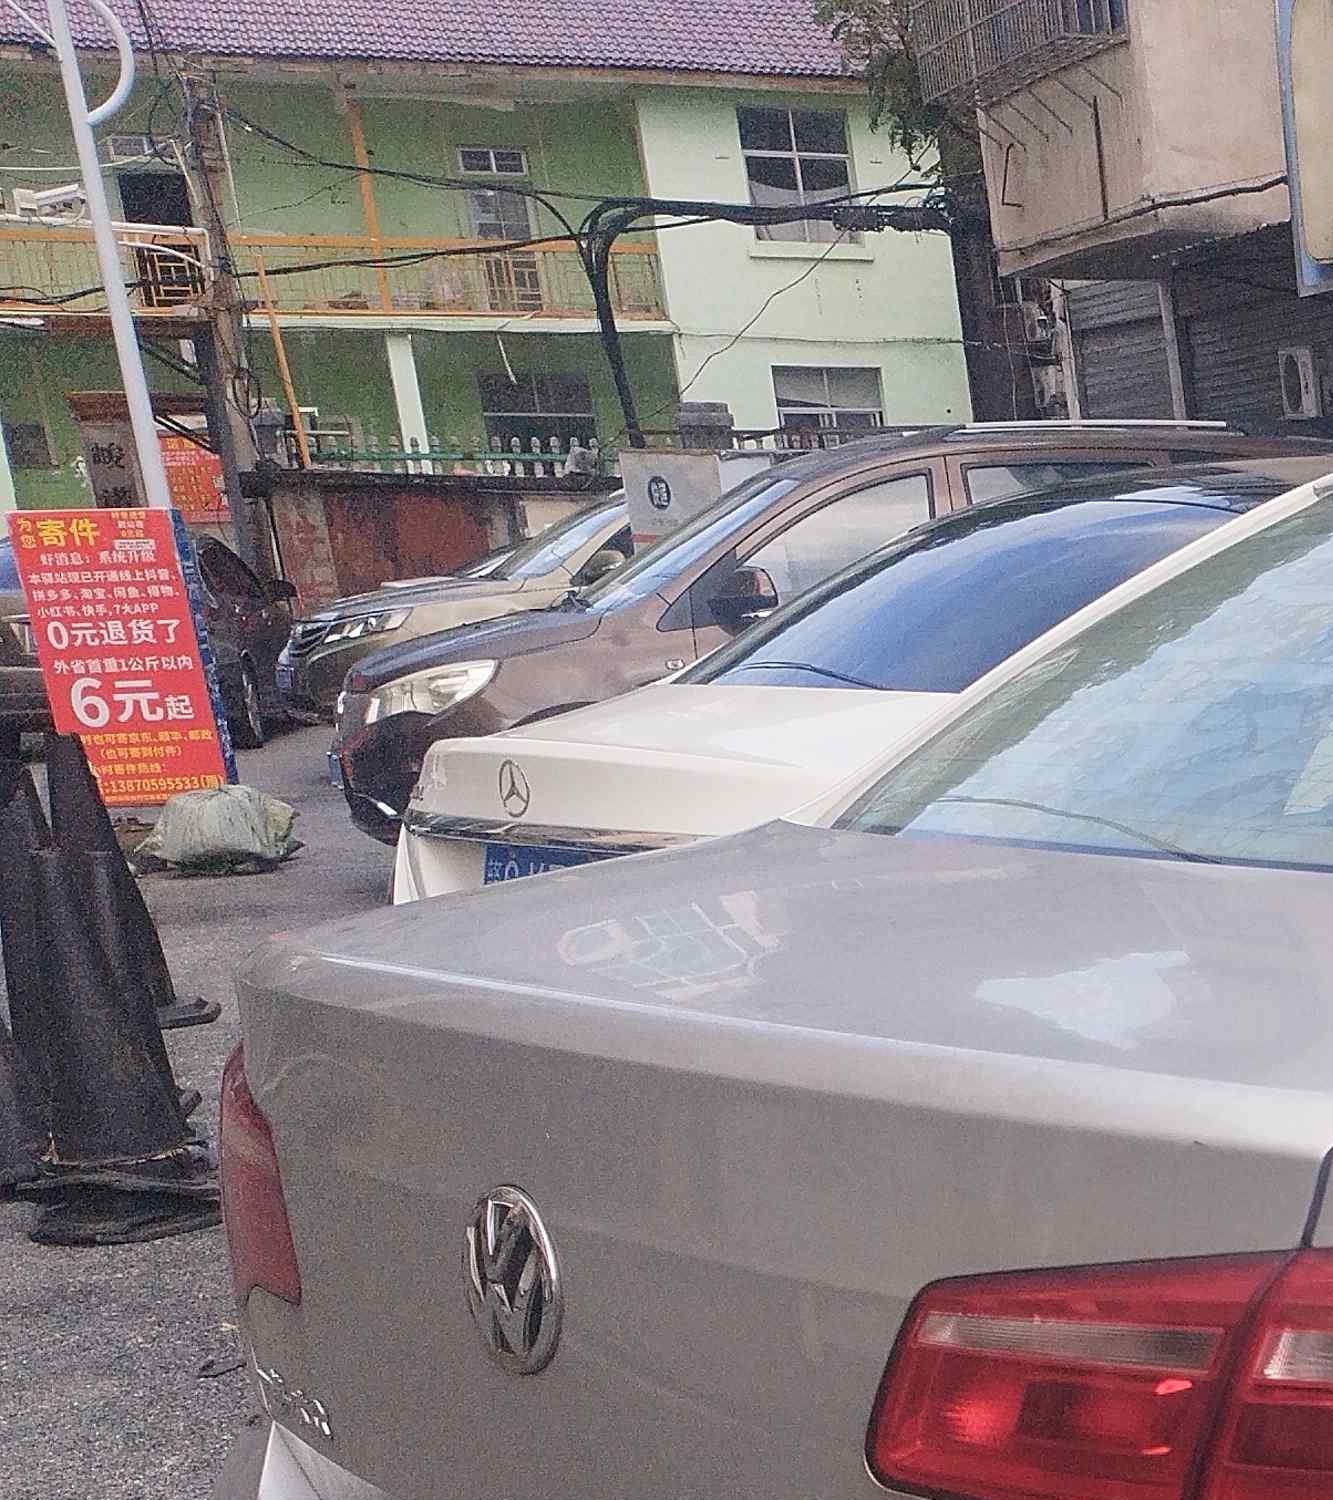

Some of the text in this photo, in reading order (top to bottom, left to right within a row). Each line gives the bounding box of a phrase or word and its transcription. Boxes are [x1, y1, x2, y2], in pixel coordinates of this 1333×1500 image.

[16, 517, 38, 549] 为您
[36, 517, 100, 548] 寄件
[46, 618, 182, 650] 0元退货了
[53, 655, 194, 676] 外省首重1公斤以内
[70, 676, 195, 728] 6元起
[80, 728, 213, 746] 时也可寄京东、顺丰、邮政
